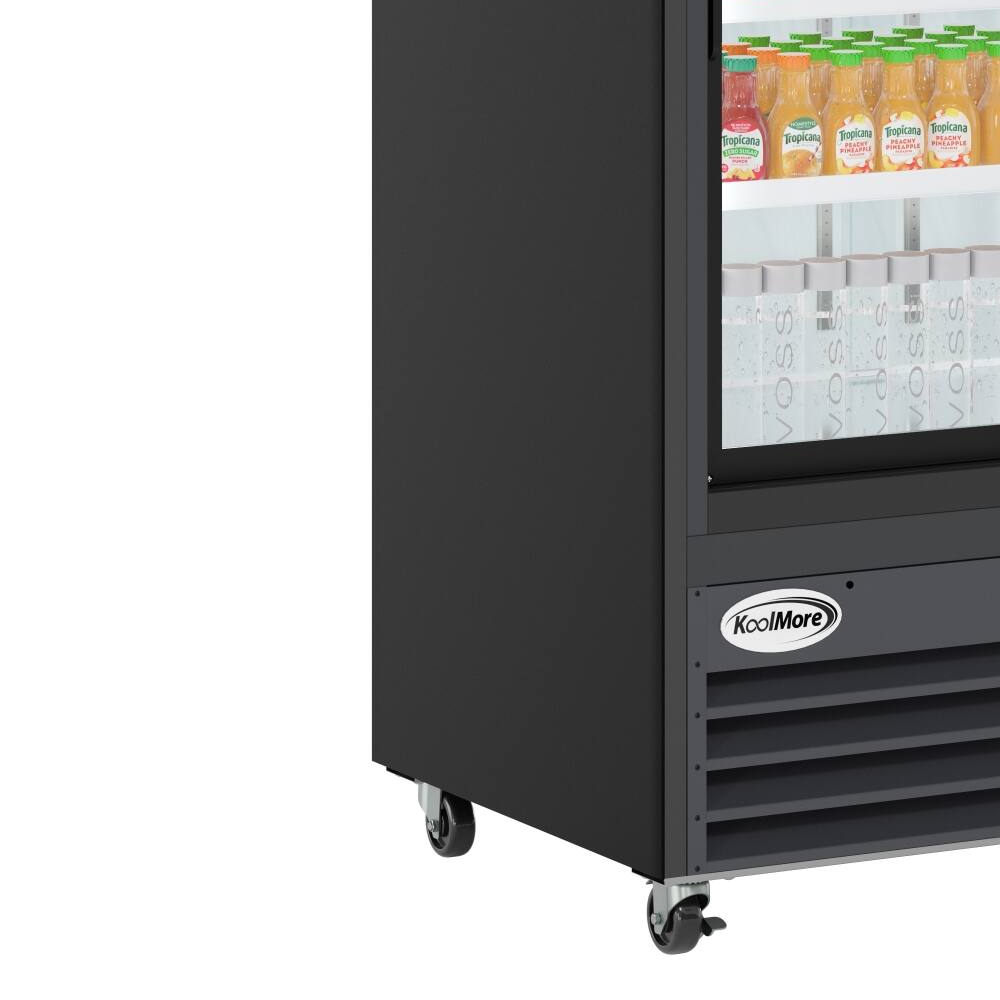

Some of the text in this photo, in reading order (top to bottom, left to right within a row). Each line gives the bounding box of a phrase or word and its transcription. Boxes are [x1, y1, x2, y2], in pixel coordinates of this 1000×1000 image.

[885, 125, 921, 138] Tropicana
[930, 121, 968, 134] Tropicana
[722, 134, 760, 147] Tropicana
[784, 131, 821, 145] Tropicana
[839, 128, 872, 141] Tropicana
[949, 296, 964, 427] VOSS
[775, 306, 793, 442] VOSS
[733, 611, 822, 634] KoolMore
